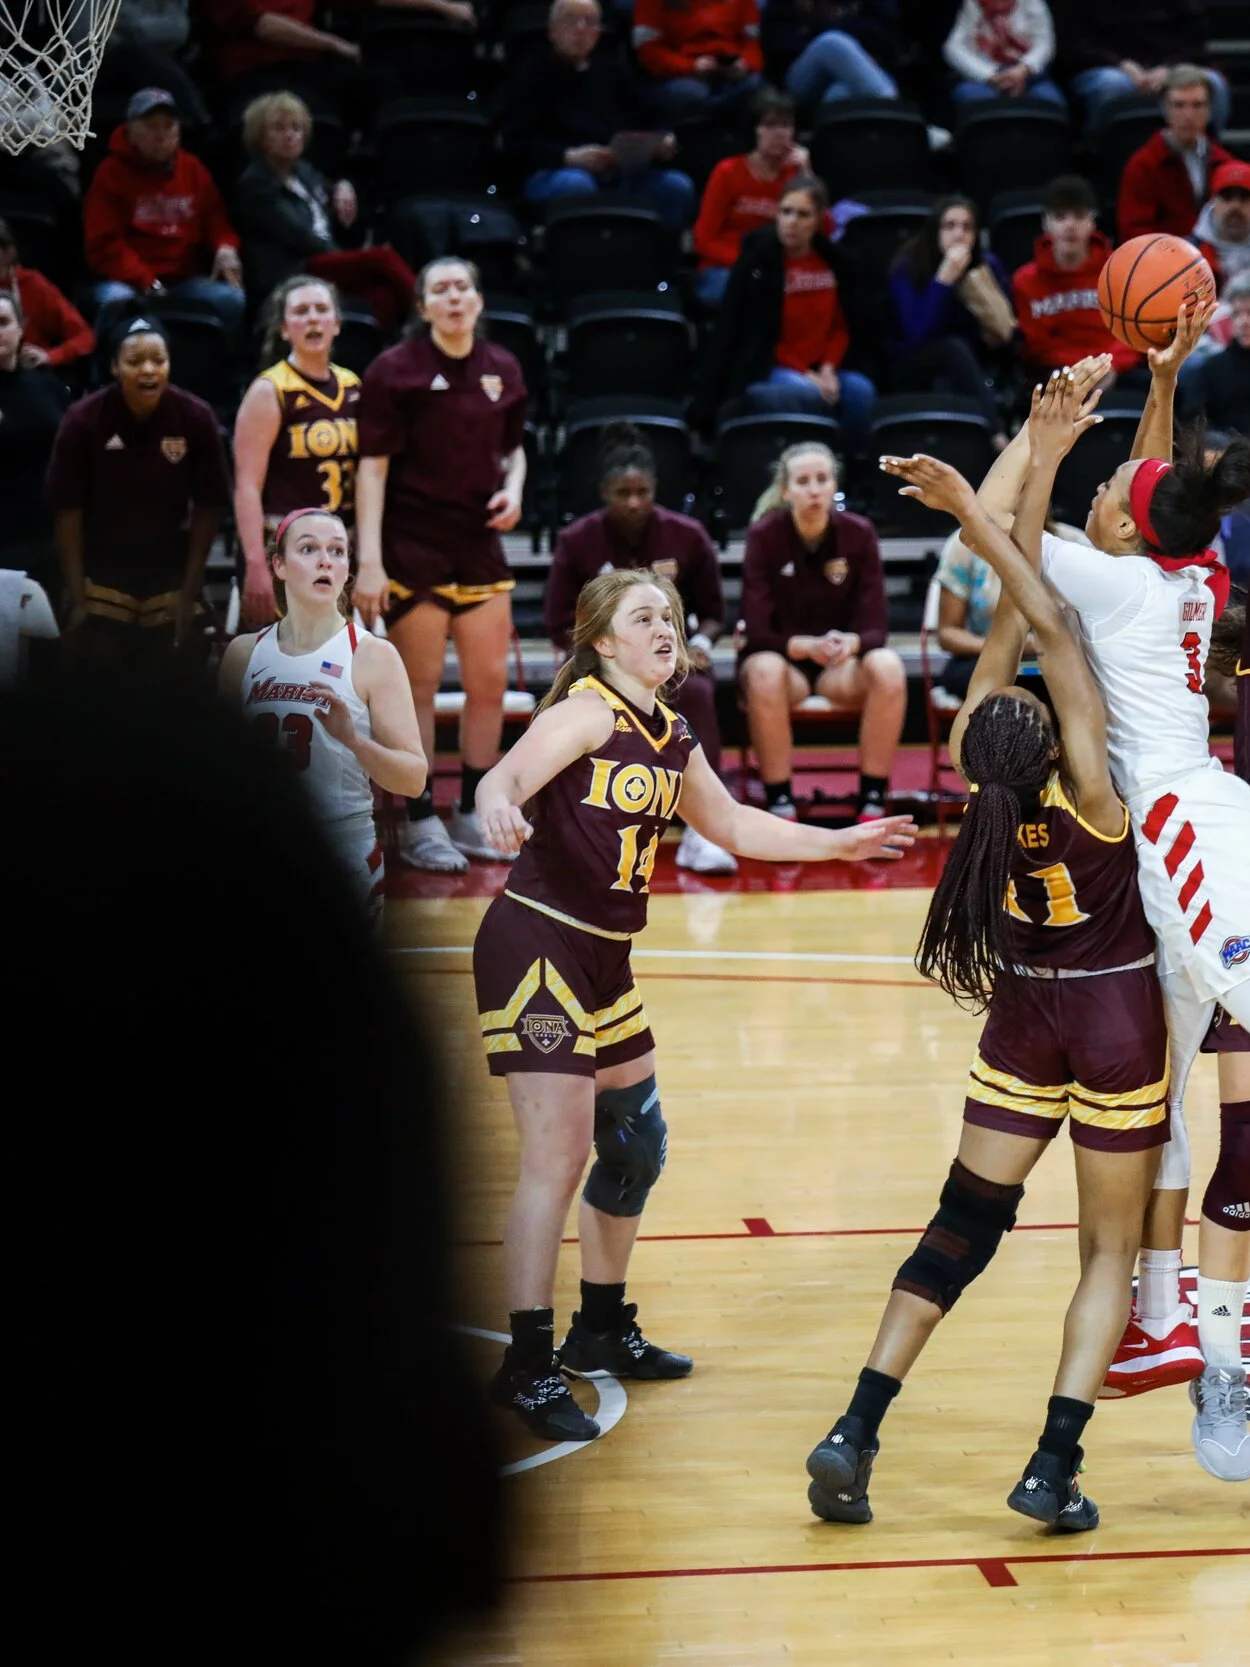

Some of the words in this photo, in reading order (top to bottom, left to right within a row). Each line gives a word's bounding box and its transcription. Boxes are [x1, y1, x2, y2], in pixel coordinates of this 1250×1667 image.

[287, 418, 358, 458] ION
[580, 757, 684, 821] ION
[1017, 822, 1051, 848] KES
[609, 824, 660, 894] 14
[520, 1017, 573, 1037] IONA
